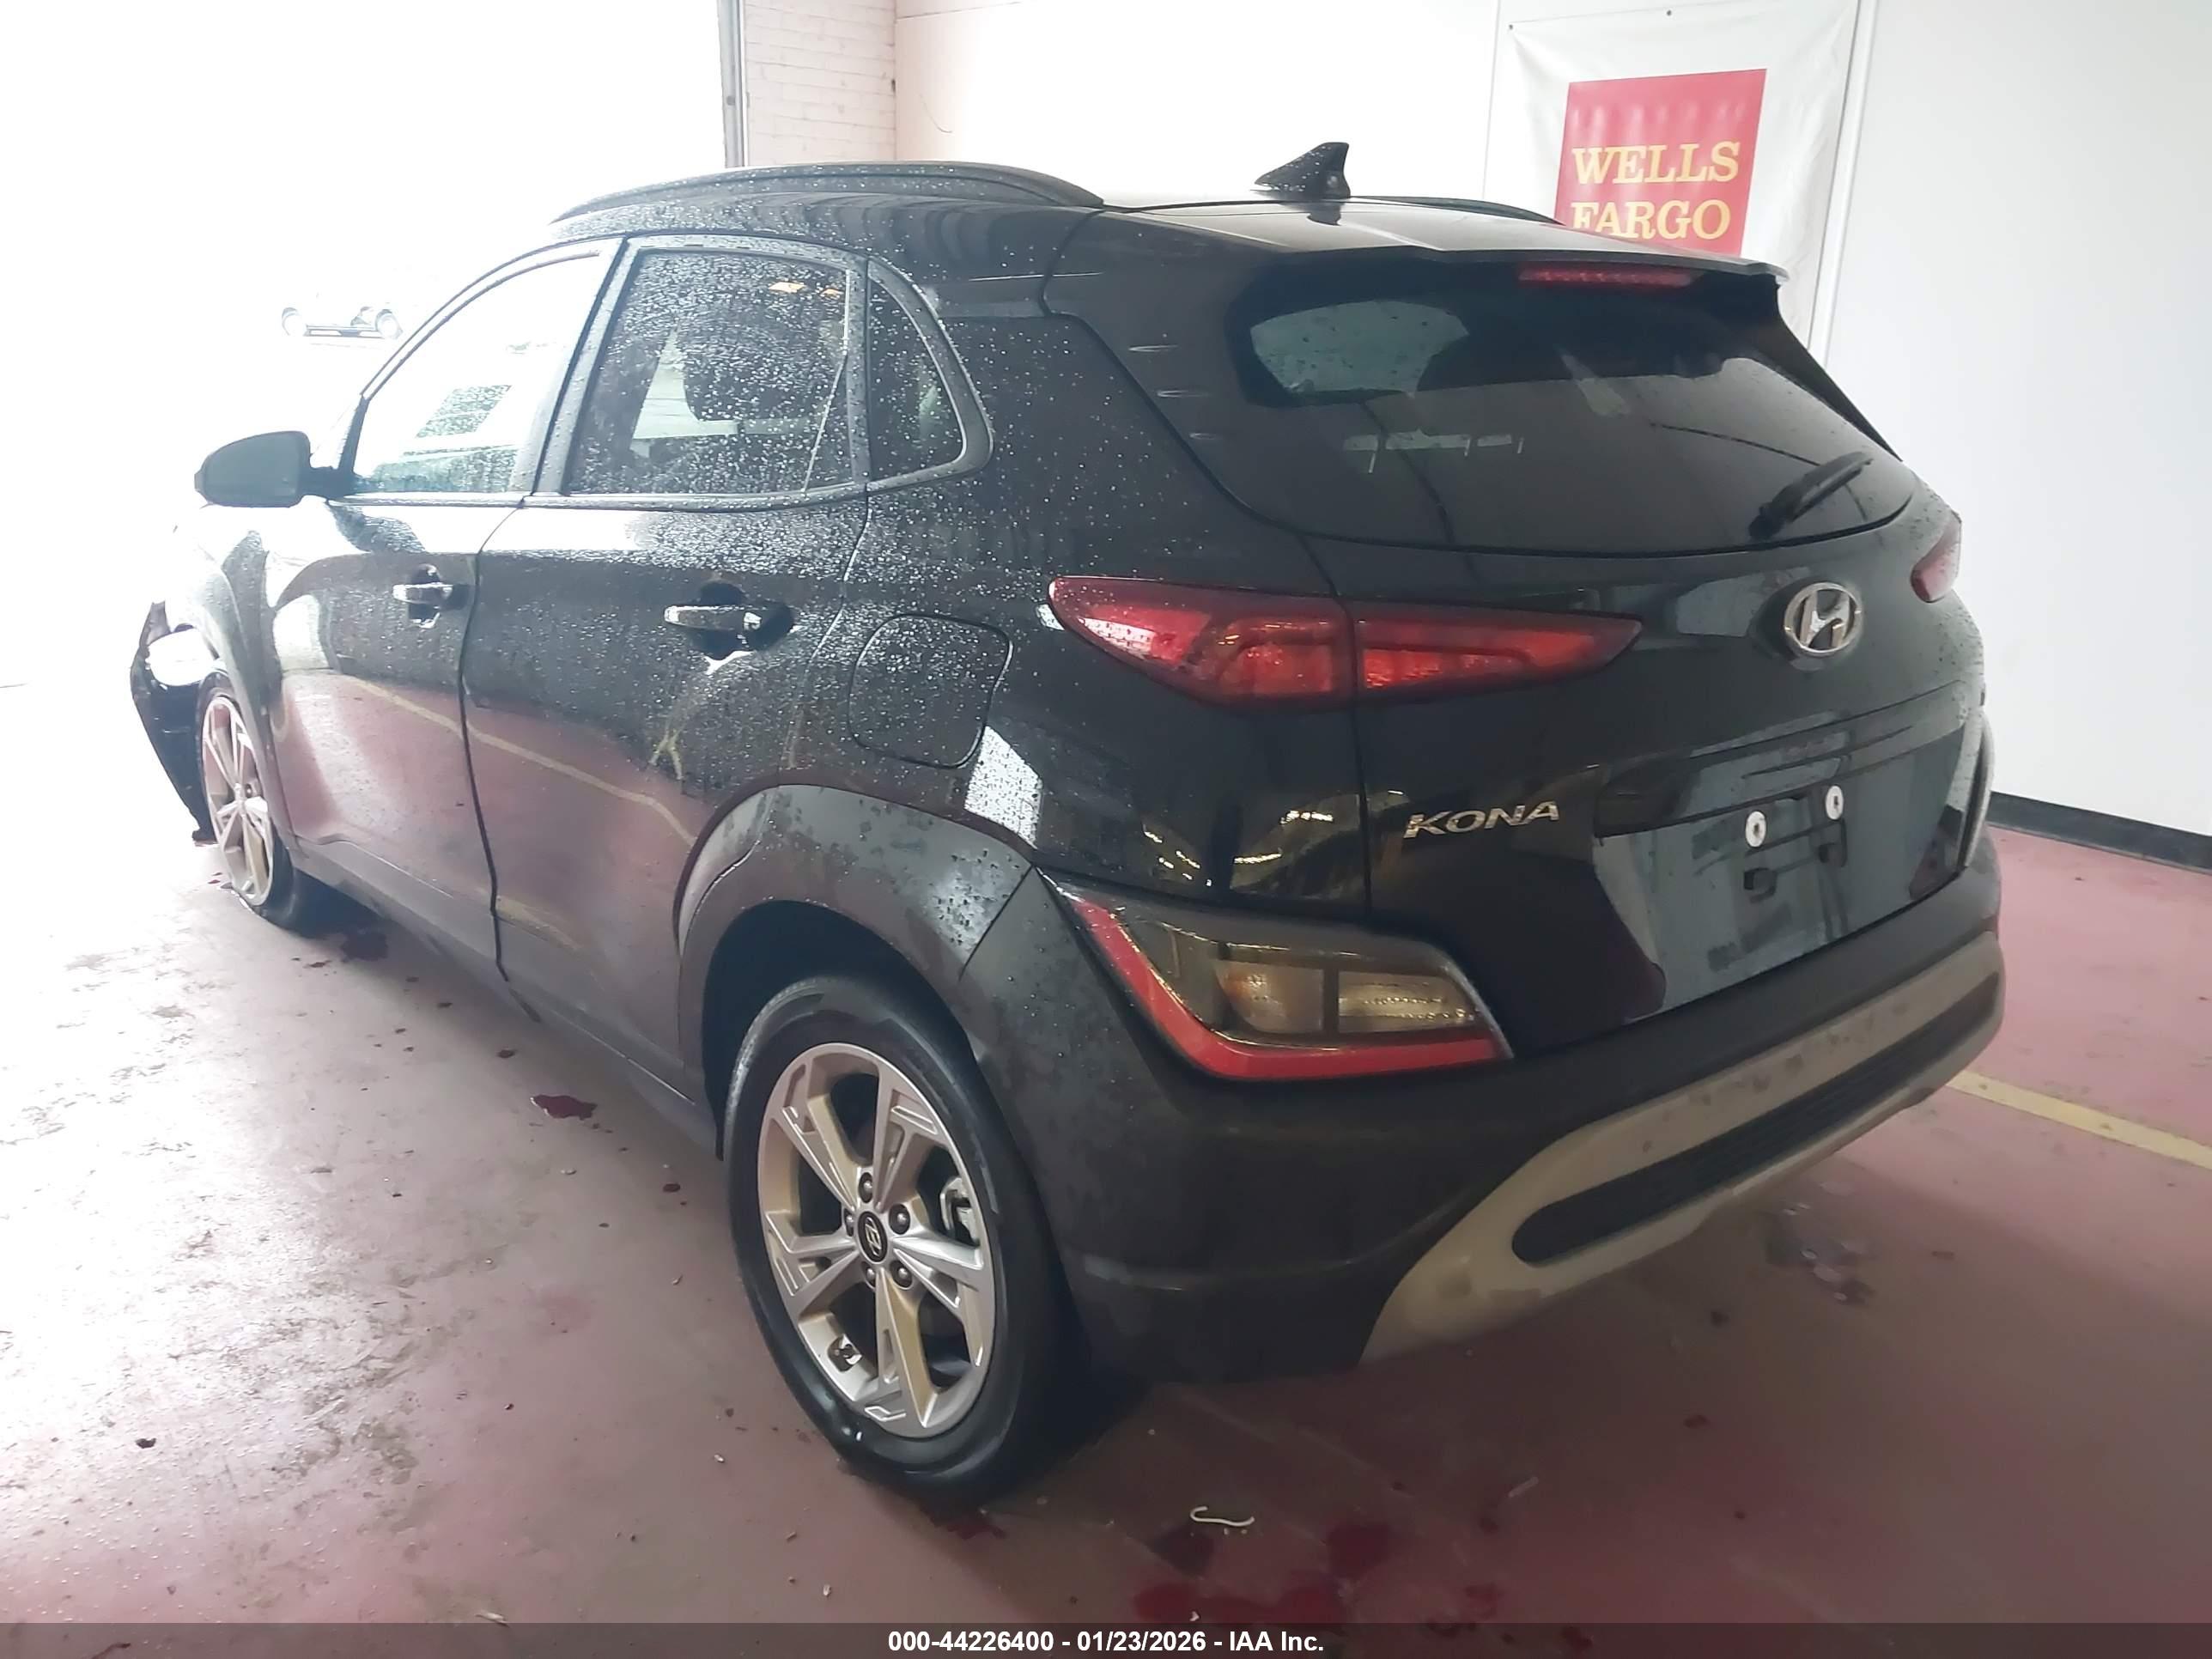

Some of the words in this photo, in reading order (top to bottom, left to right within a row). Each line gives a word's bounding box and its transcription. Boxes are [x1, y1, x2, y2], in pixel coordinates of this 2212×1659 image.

[1572, 141, 1740, 184] WELLS
[1571, 199, 1731, 240] FARGO
[1403, 801, 1559, 838] KONA
